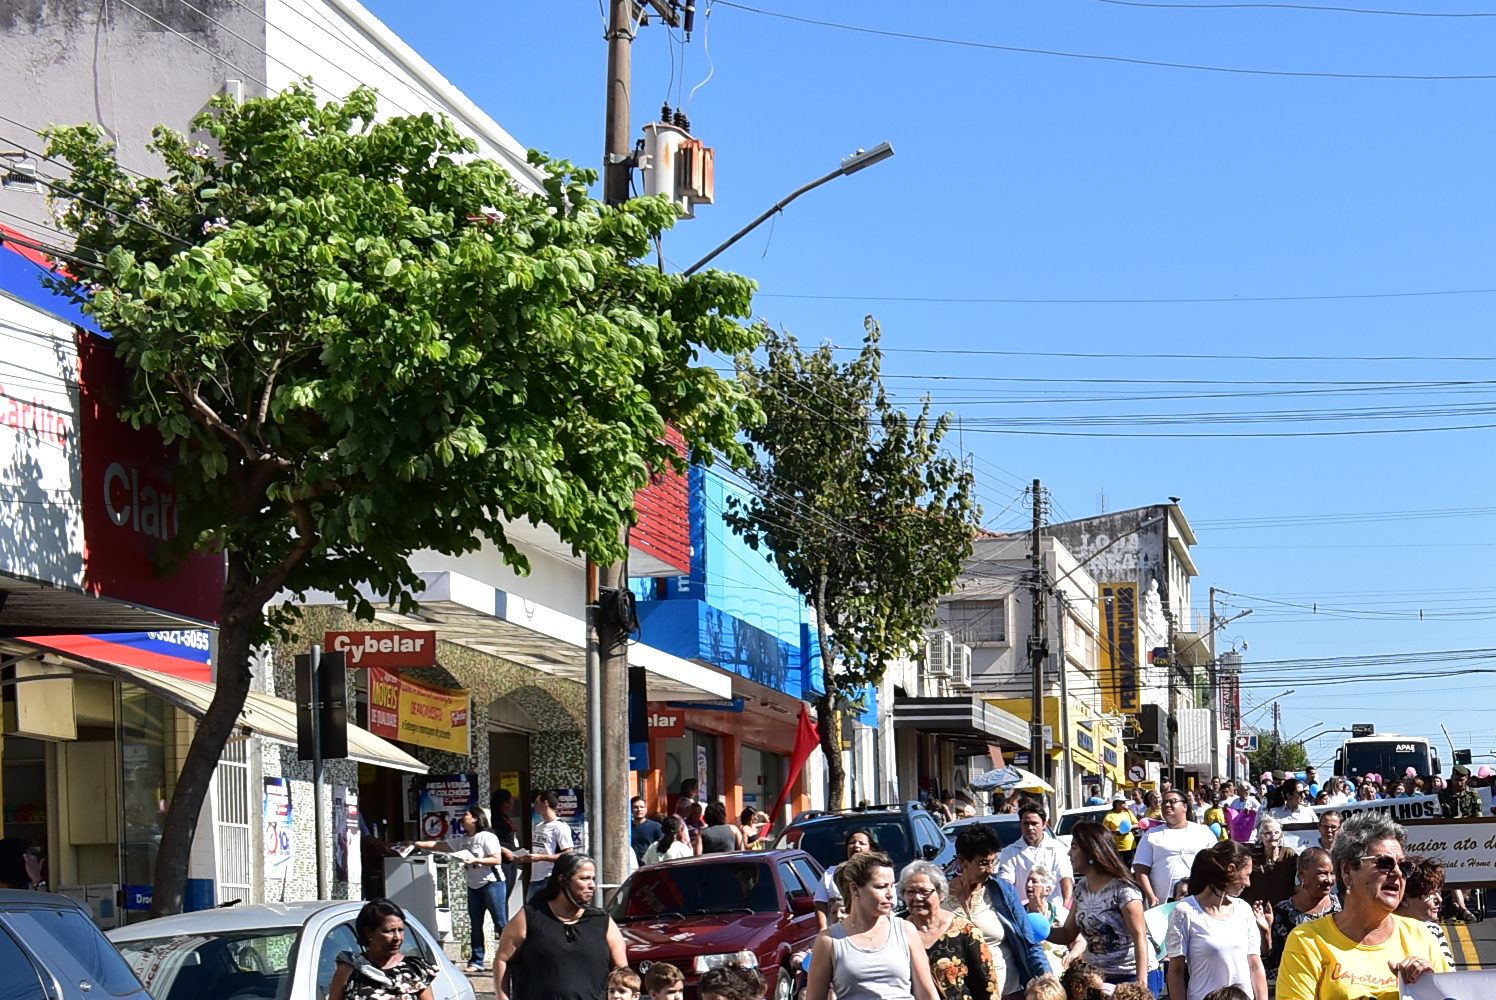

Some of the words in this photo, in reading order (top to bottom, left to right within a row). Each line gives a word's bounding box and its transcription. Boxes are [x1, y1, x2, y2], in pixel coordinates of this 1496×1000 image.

[104, 462, 179, 540] Clar
[334, 635, 424, 663] Cybelar
[1453, 837, 1478, 850] ato
[1467, 858, 1490, 867] Home
